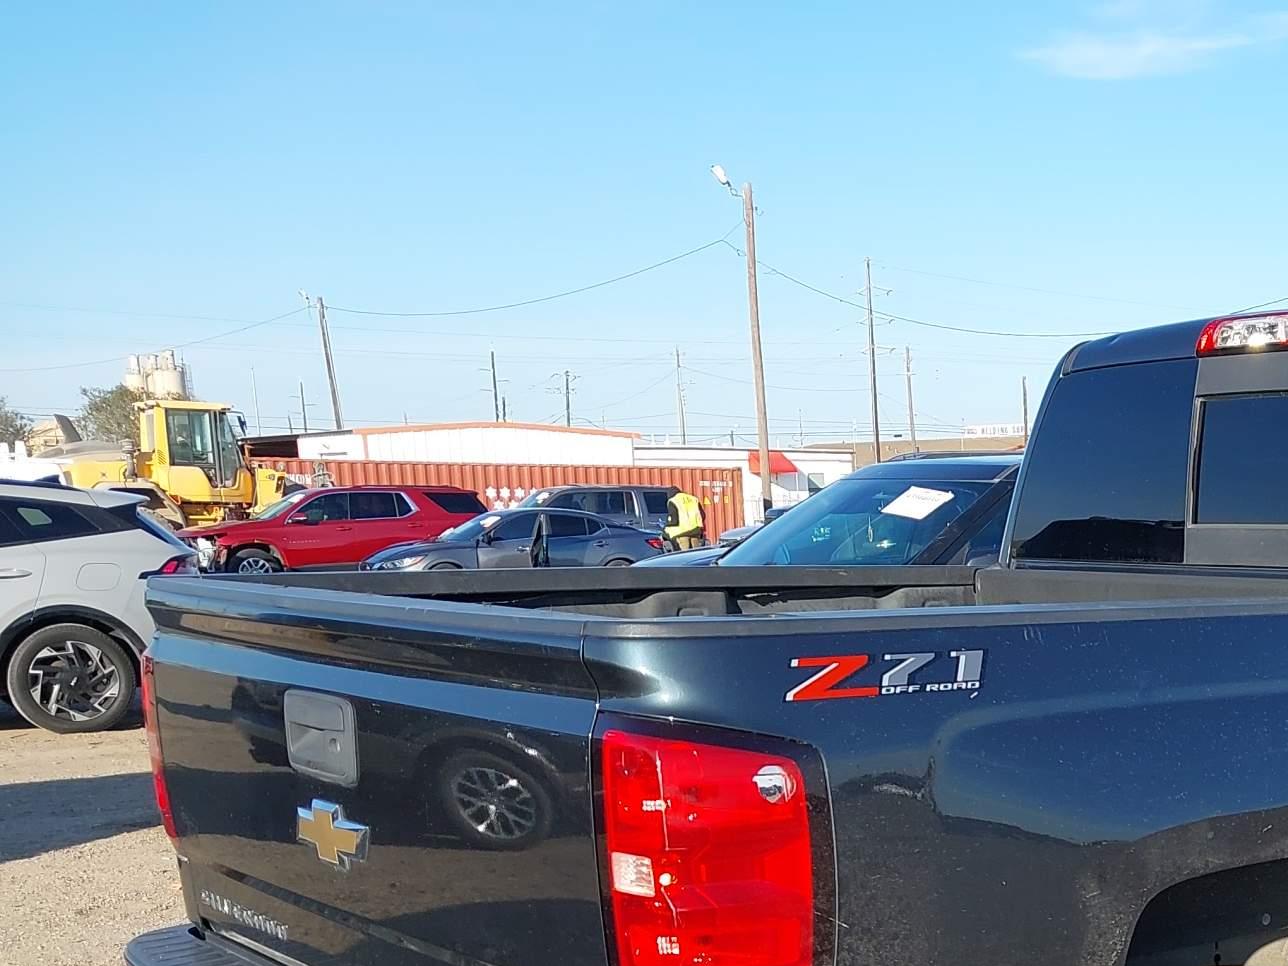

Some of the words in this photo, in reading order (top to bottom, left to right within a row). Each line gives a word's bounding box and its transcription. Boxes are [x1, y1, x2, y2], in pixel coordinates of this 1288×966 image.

[785, 649, 984, 702] Z71
[881, 684, 920, 695] OFF
[926, 680, 980, 692] ROAD
